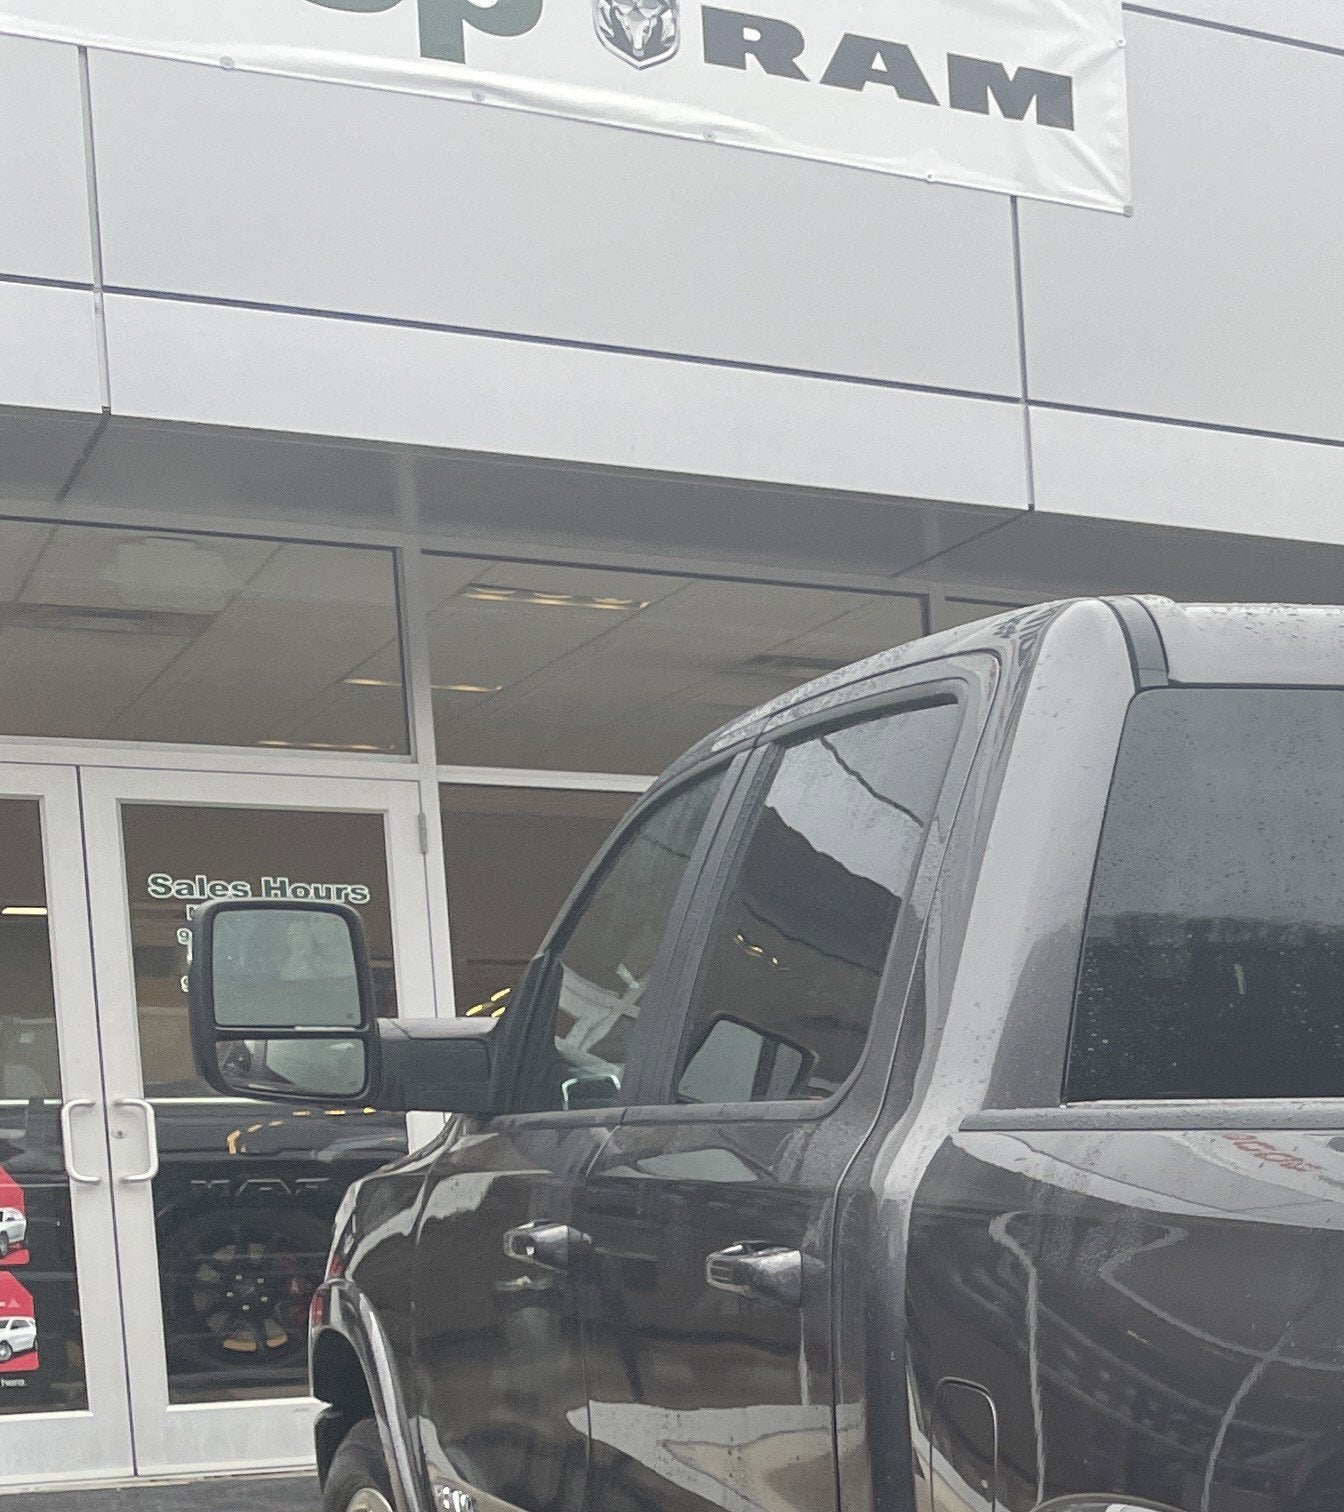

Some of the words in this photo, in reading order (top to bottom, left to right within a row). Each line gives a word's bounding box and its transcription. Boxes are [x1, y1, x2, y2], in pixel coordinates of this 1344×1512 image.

[702, 6, 1075, 131] RAM
[148, 873, 251, 899] Sales
[261, 877, 370, 904] Hours
